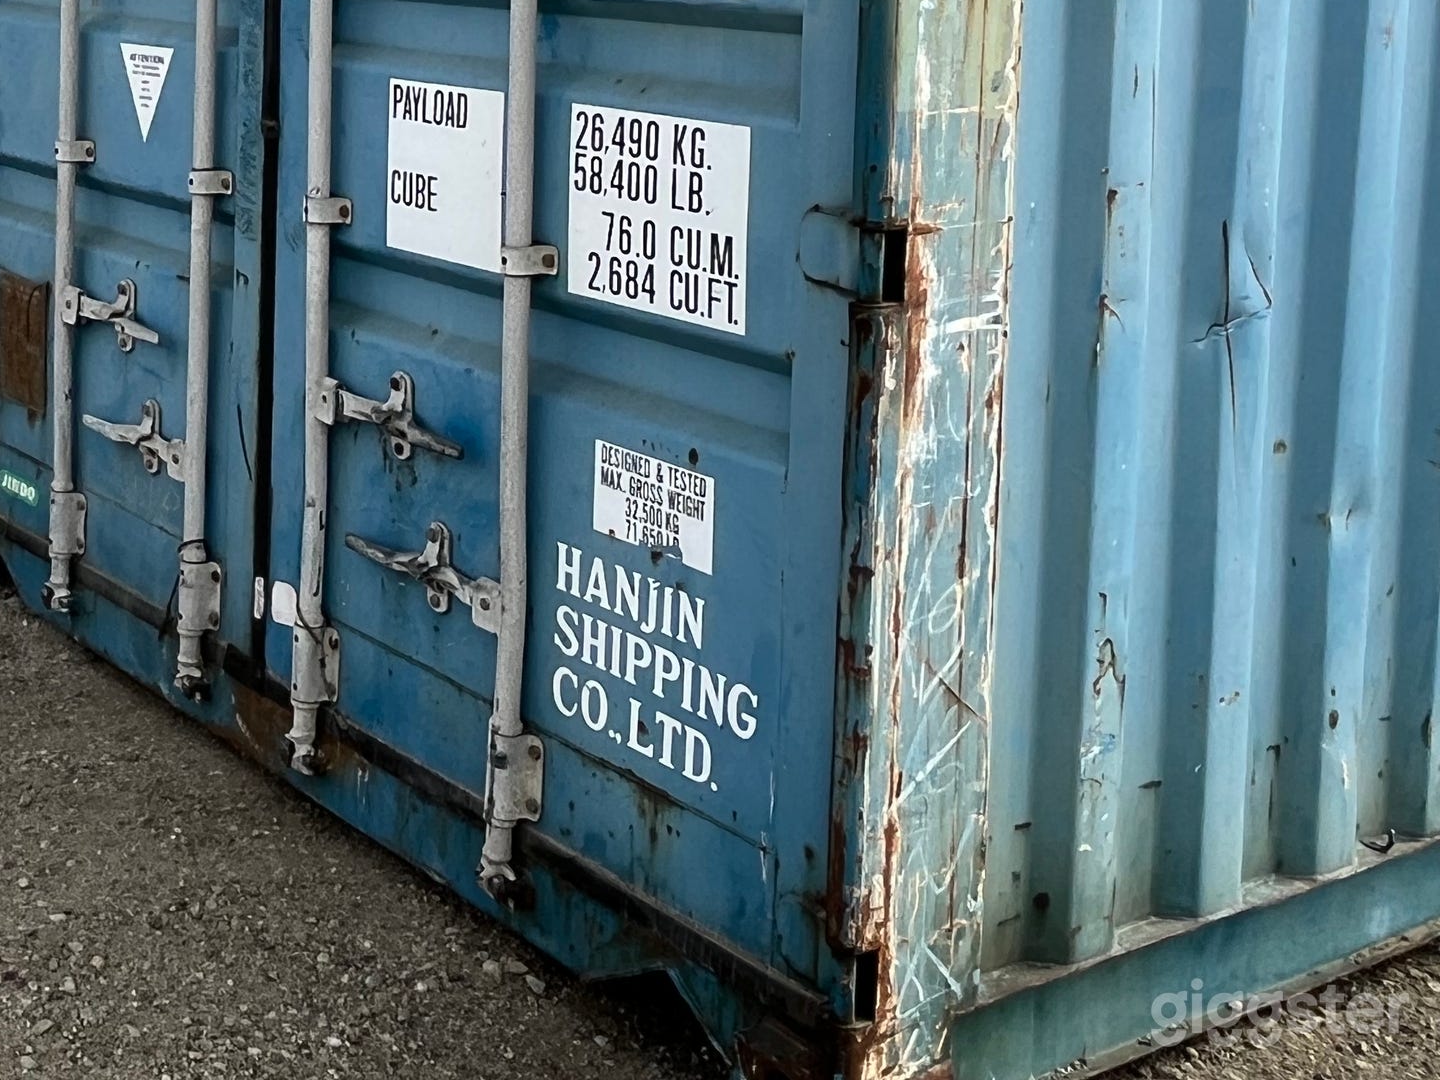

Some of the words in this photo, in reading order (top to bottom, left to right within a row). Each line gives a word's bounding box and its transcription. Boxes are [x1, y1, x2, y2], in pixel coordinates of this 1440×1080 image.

[392, 84, 468, 129] PAYLOAD
[575, 111, 659, 161] 26,490
[673, 123, 712, 170] KG.
[391, 169, 438, 212] CUBE
[574, 152, 657, 204] 58,400
[671, 168, 711, 216] LB.
[601, 211, 656, 260] 76.0
[588, 251, 656, 304] 2,684
[601, 443, 650, 479] DESIGNED
[656, 463, 664, 483] &
[667, 466, 707, 498] TESTED
[601, 466, 626, 493] MAX.
[629, 476, 663, 507] GROSS
[667, 489, 706, 521] WEIGHT
[665, 511, 680, 535] KG
[554, 605, 758, 740] SHIPPING
